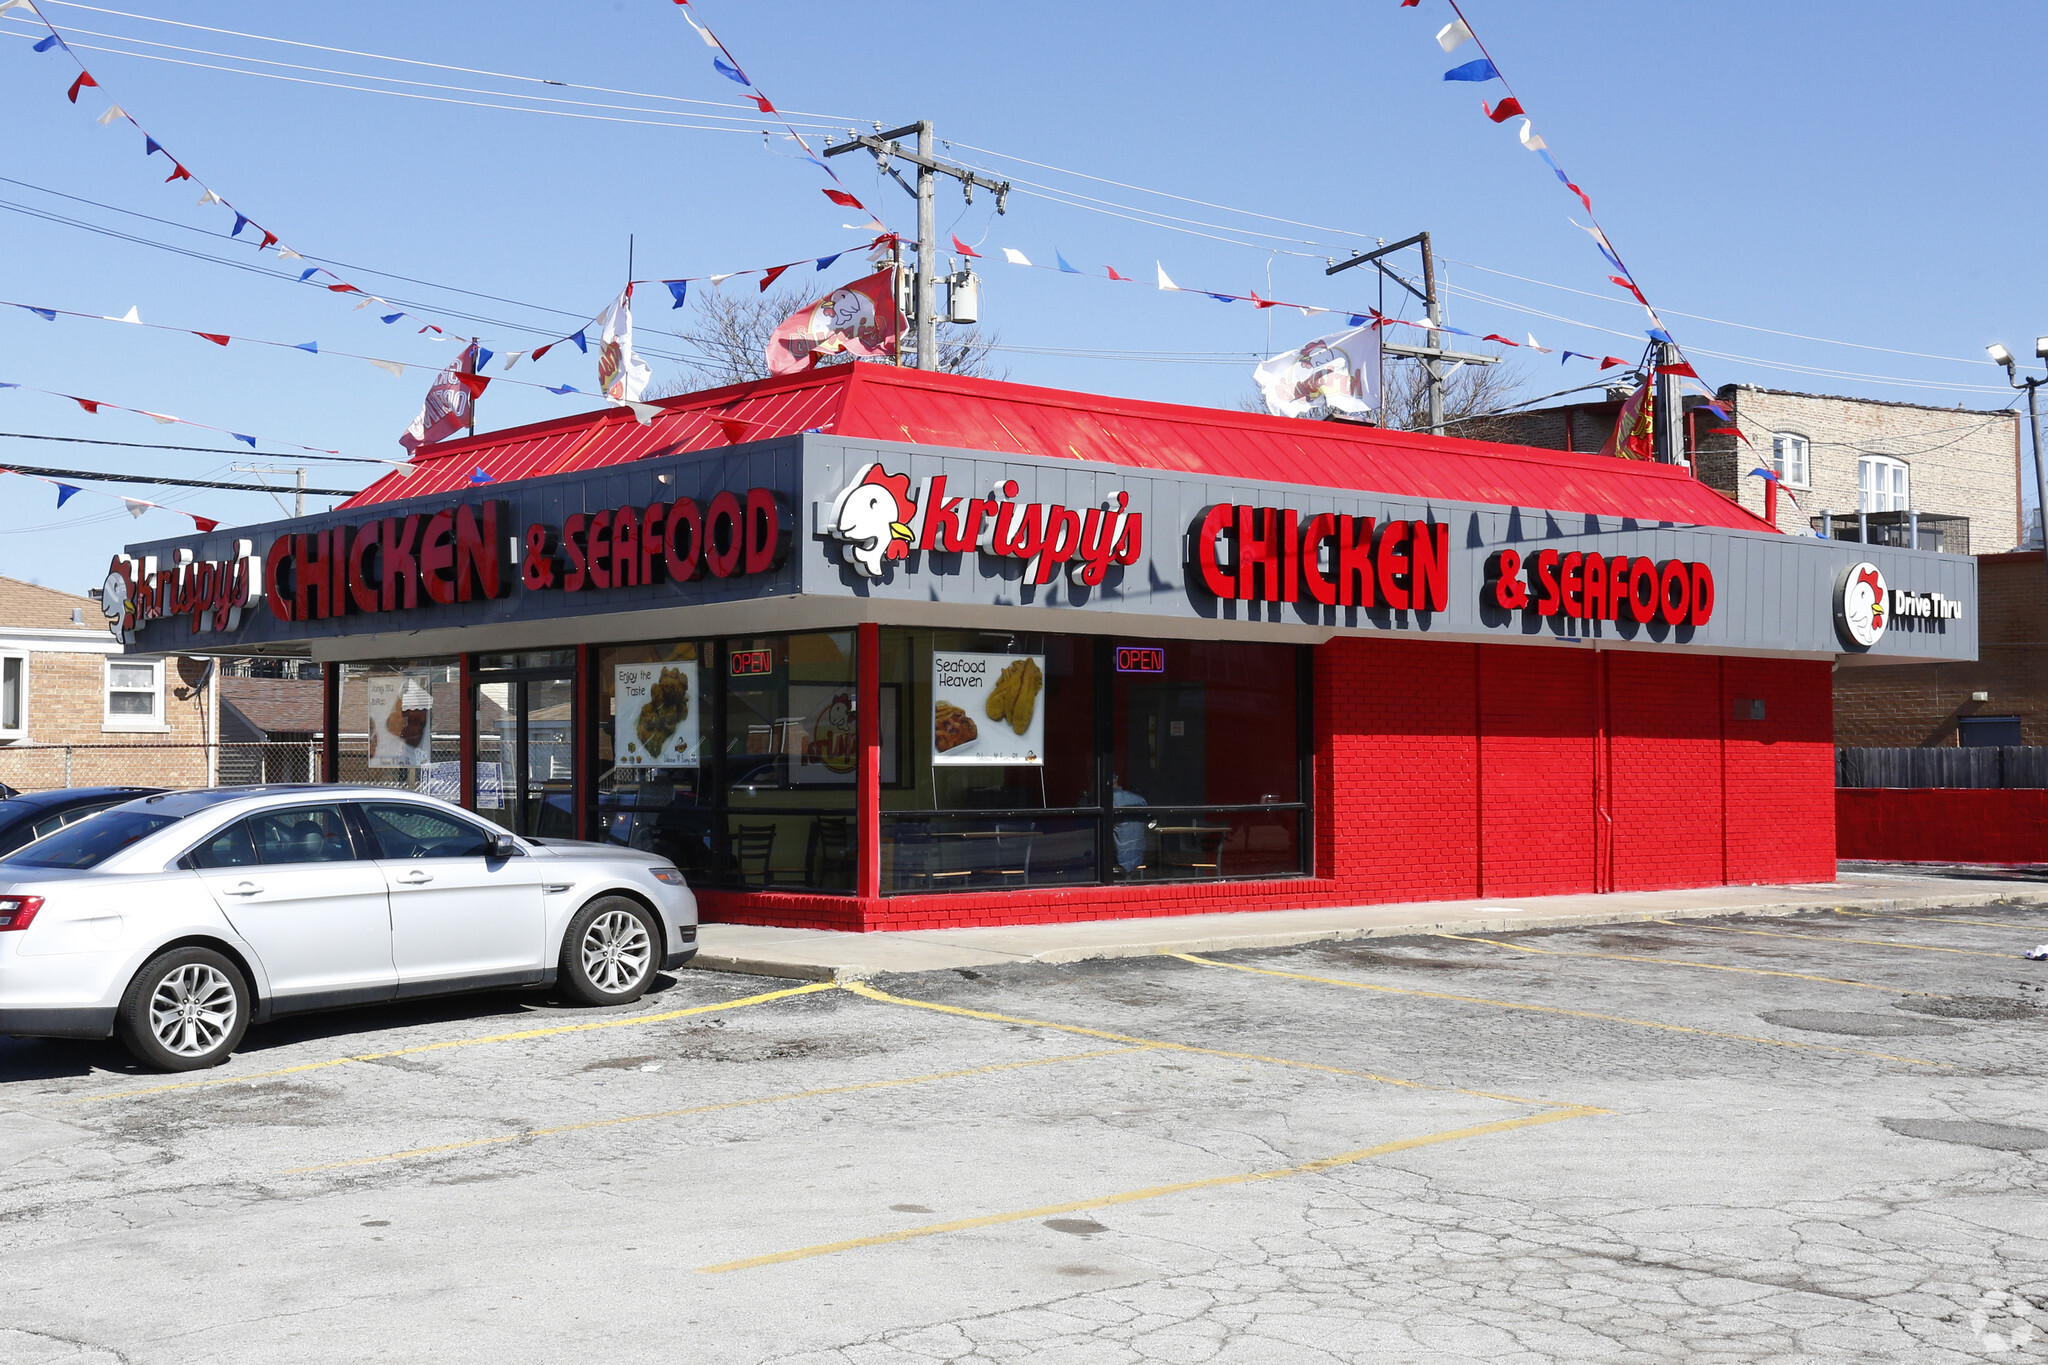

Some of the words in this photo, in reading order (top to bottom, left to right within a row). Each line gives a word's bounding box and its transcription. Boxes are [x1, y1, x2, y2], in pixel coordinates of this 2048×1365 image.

[137, 539, 249, 634] krispy's
[265, 500, 501, 622] CHICKEN
[523, 523, 554, 591] &
[563, 487, 779, 593] SEAFOOD
[921, 476, 1142, 586] krispy's
[1199, 503, 1449, 612] CHICKEN
[1496, 549, 1529, 610] &
[1537, 549, 1715, 627] SEAFOOD
[1895, 589, 1931, 617] Drive
[1931, 592, 1962, 619] Thru
[732, 652, 770, 674] OPEN
[935, 658, 986, 673] Seafood
[1119, 650, 1162, 670] OPEN
[619, 671, 638, 684] Enjoy
[640, 670, 652, 680] the
[939, 673, 983, 687] Heaven
[626, 686, 646, 696] Taste
